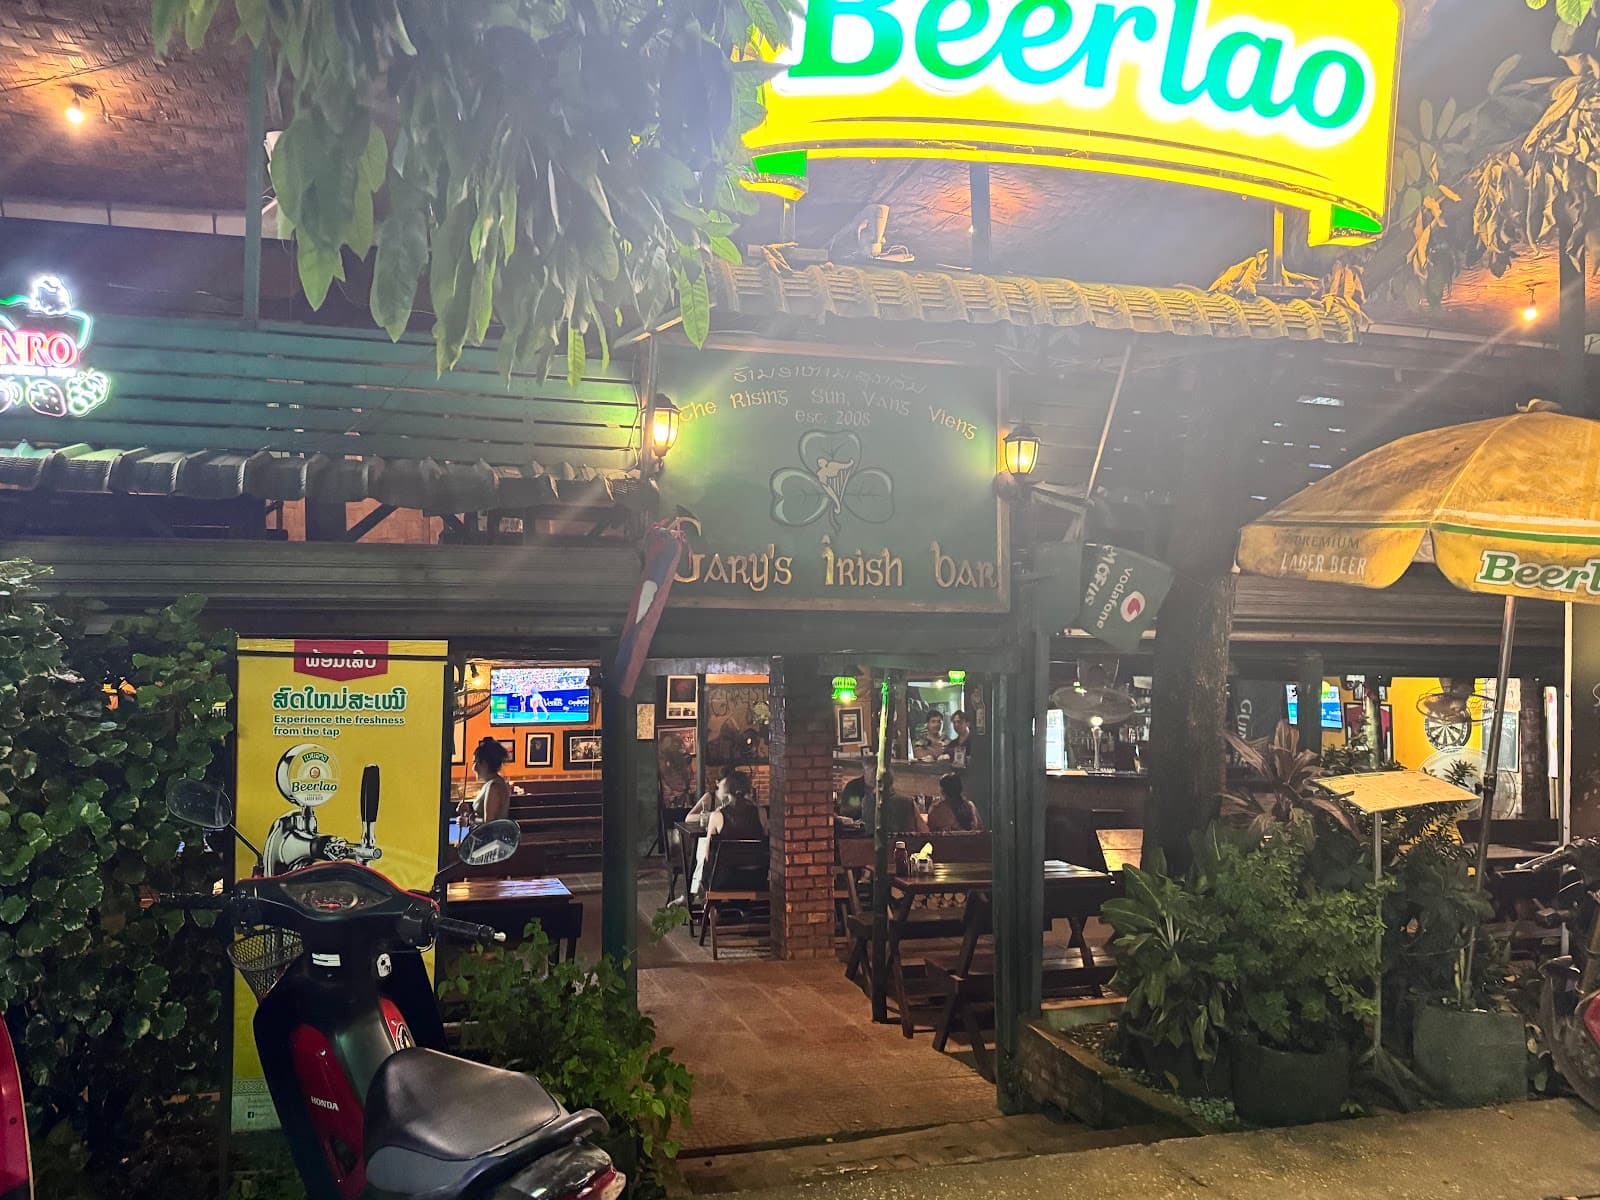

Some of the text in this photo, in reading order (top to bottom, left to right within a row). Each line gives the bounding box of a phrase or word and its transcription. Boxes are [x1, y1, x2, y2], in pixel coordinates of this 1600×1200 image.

[787, 0, 1366, 129] Beerlao
[729, 388, 789, 409] Rising
[862, 391, 912, 416] Vang
[928, 405, 977, 440] Vieng
[836, 409, 872, 426] 2008
[1280, 551, 1368, 577] LAGER BEER
[1096, 567, 1134, 630] vodafone
[273, 714, 405, 725] Experience the freshness
[273, 726, 340, 738] from the tap
[291, 780, 338, 793] Beerlao
[311, 1096, 339, 1111] HONDA
